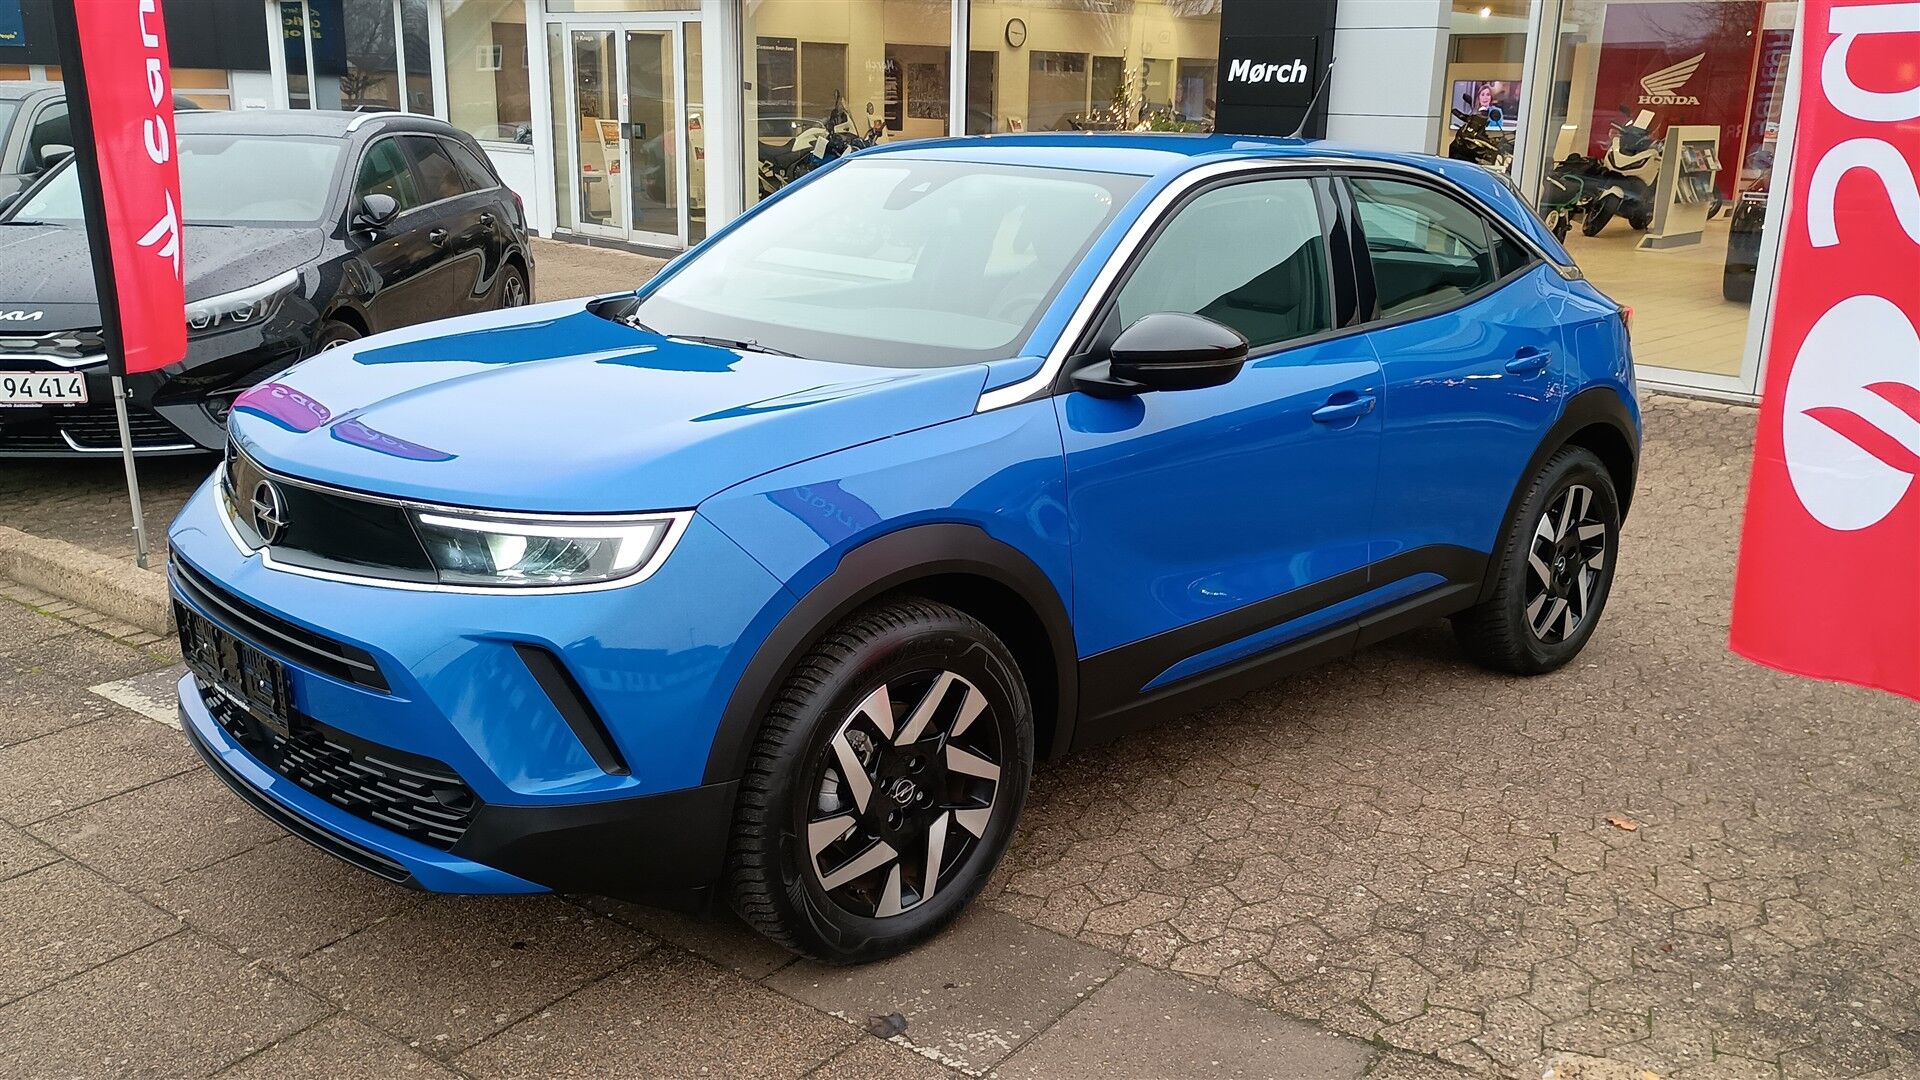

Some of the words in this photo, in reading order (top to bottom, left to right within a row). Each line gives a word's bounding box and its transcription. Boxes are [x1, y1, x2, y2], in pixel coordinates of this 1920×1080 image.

[1227, 58, 1308, 84] Mørch
[1637, 95, 1701, 106] HONDA
[3, 377, 33, 398] 94
[38, 377, 82, 398] 414
